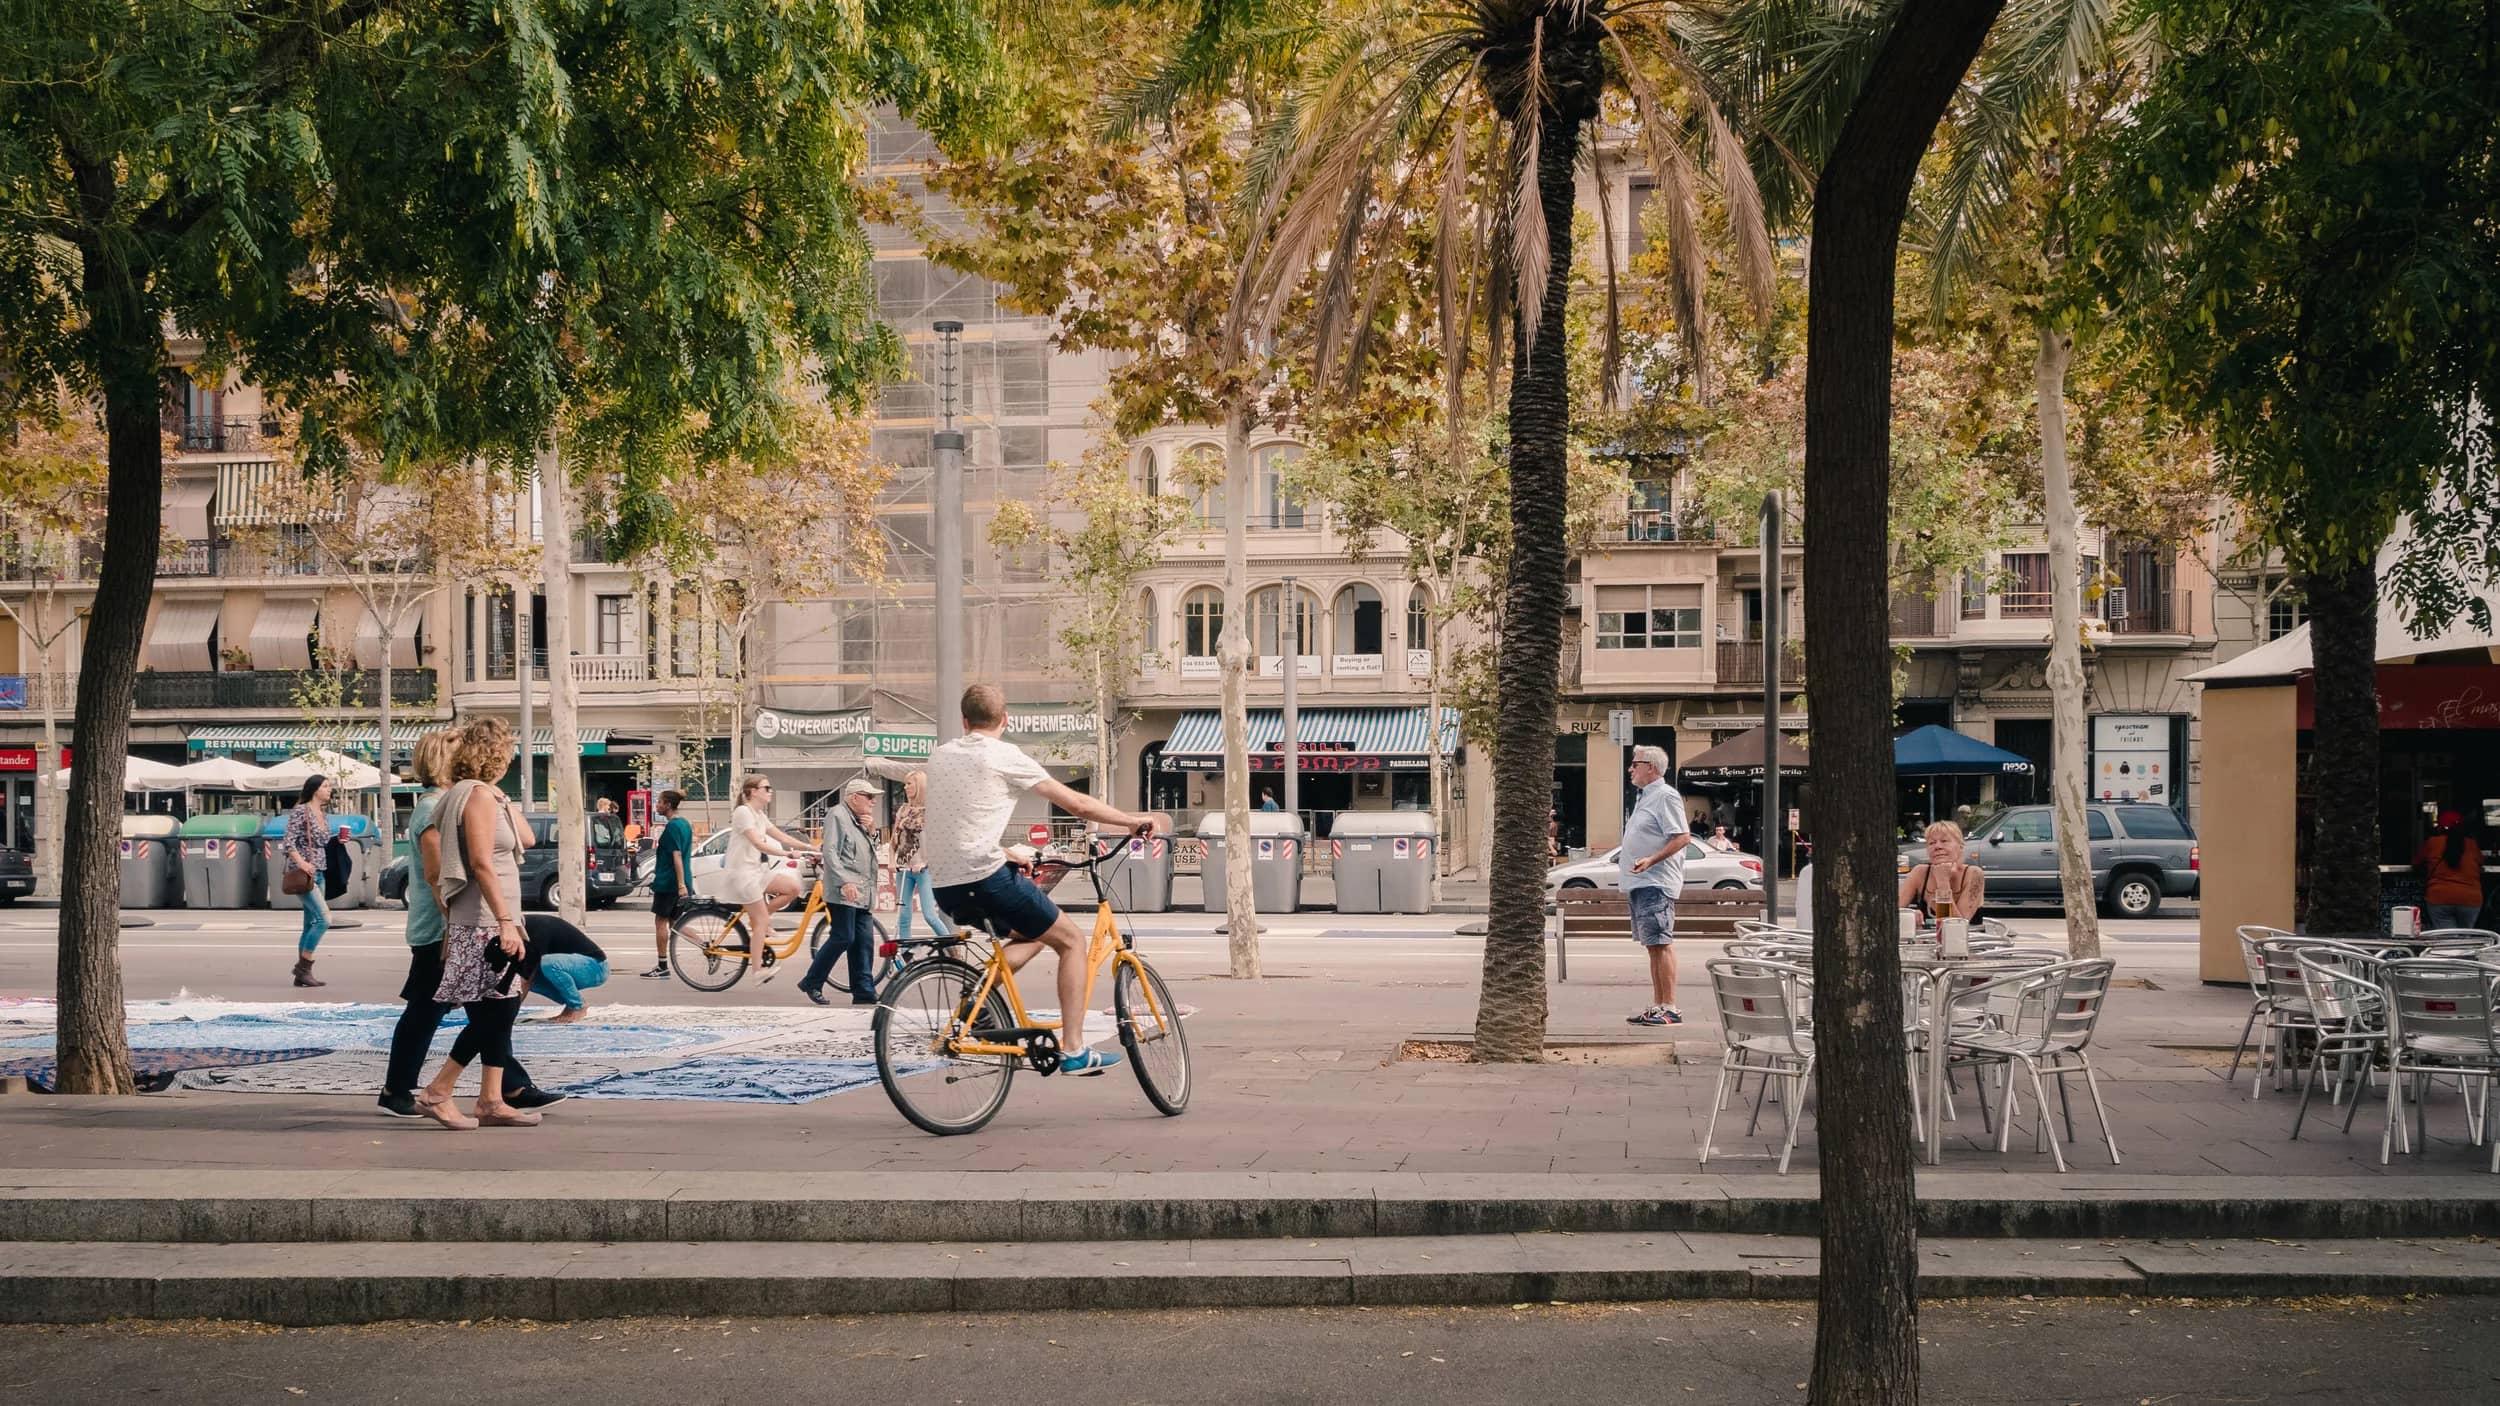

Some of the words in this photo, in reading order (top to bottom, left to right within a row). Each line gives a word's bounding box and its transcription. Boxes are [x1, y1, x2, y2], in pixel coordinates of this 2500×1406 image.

[780, 715, 871, 734] SUPERMERCAT
[1007, 713, 1097, 733] SUPERMERCAT
[1571, 722, 1601, 732] RUIZ
[205, 740, 286, 750] RESTAURANTE
